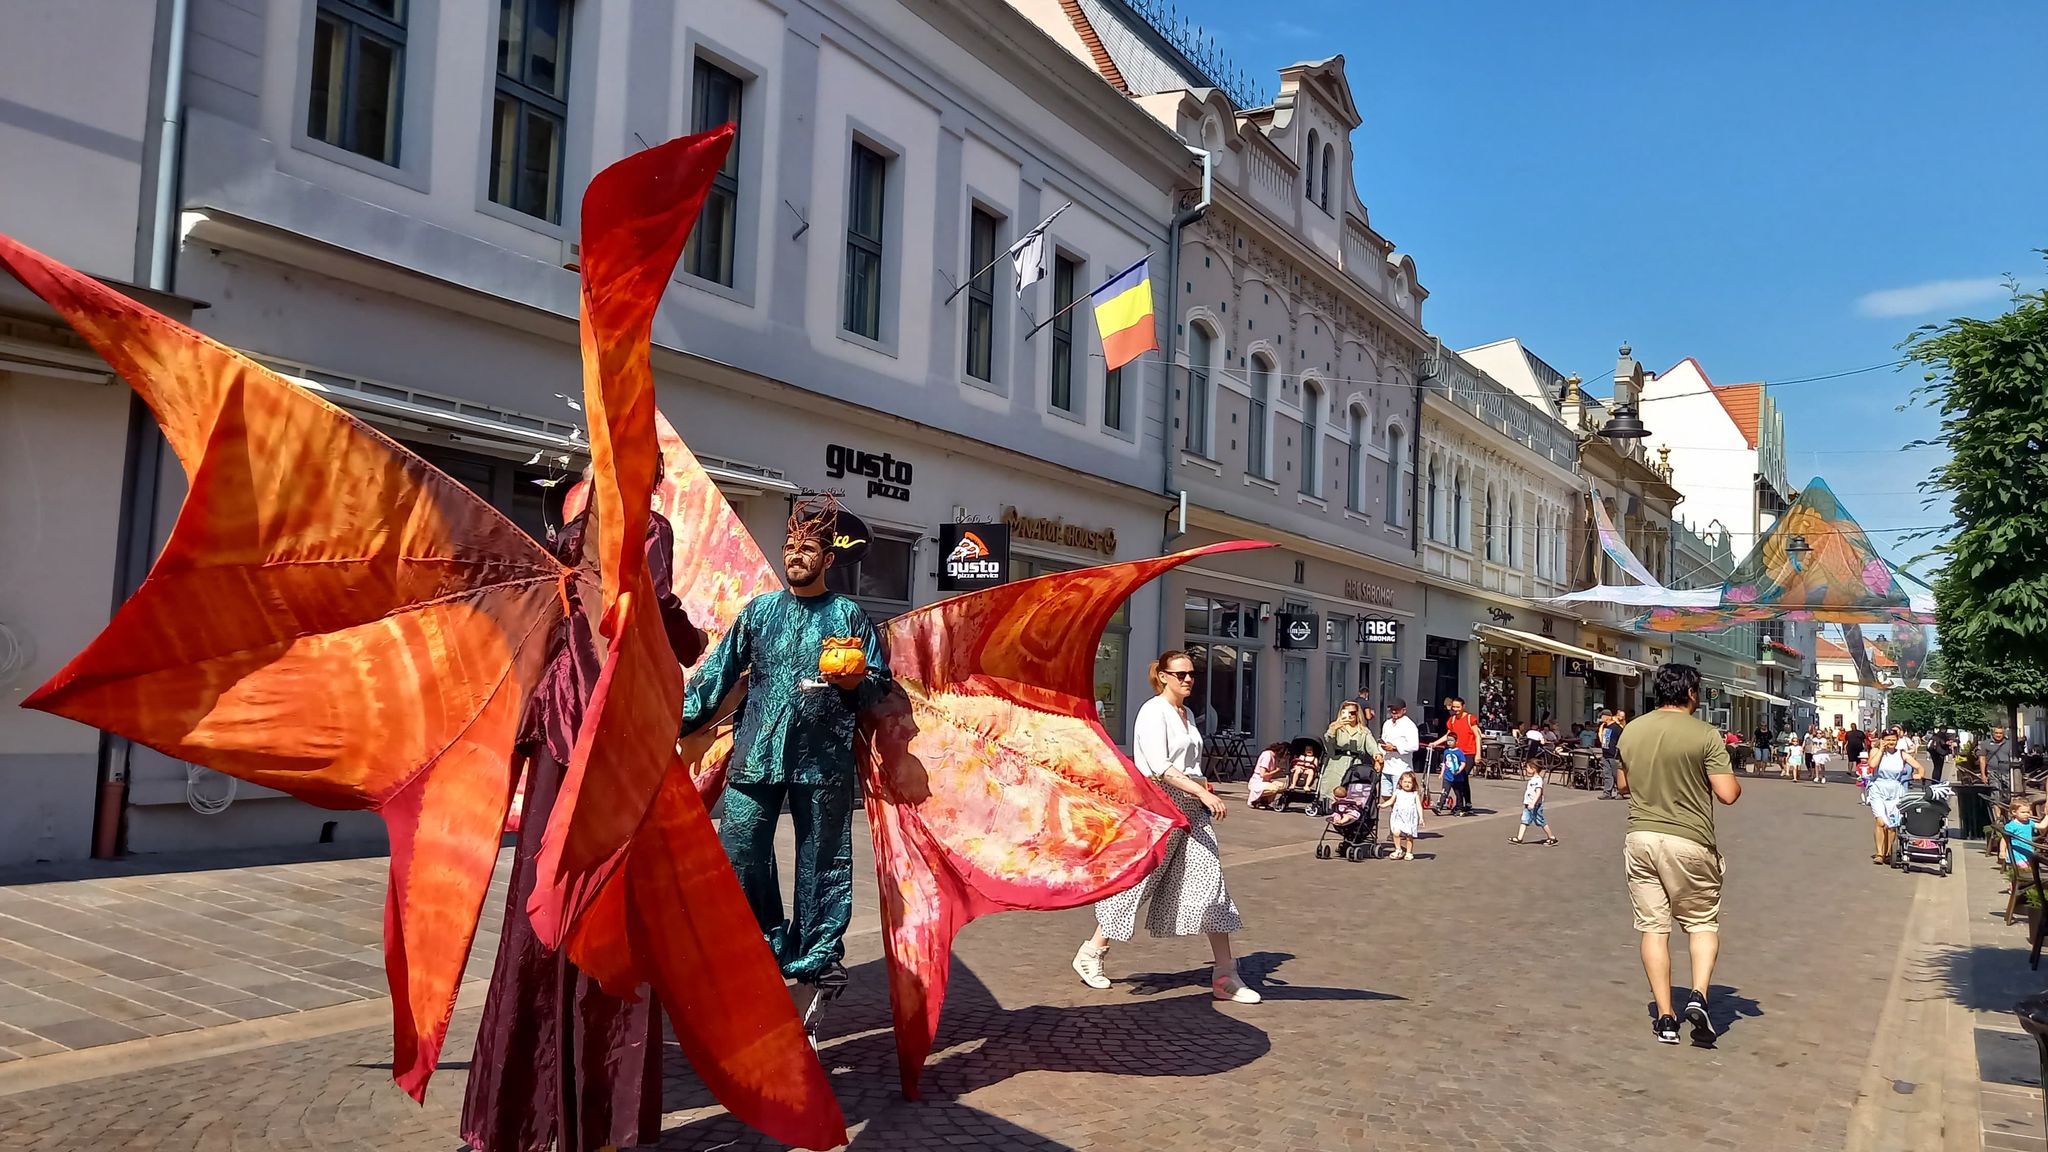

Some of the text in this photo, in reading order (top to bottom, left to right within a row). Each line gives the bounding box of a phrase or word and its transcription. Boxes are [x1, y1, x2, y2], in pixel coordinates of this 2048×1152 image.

[826, 444, 912, 485] gusto
[867, 479, 910, 502] pizza
[947, 560, 999, 577] gusto
[1361, 582, 1395, 607] SABOMAG
[1365, 620, 1396, 635] ABC
